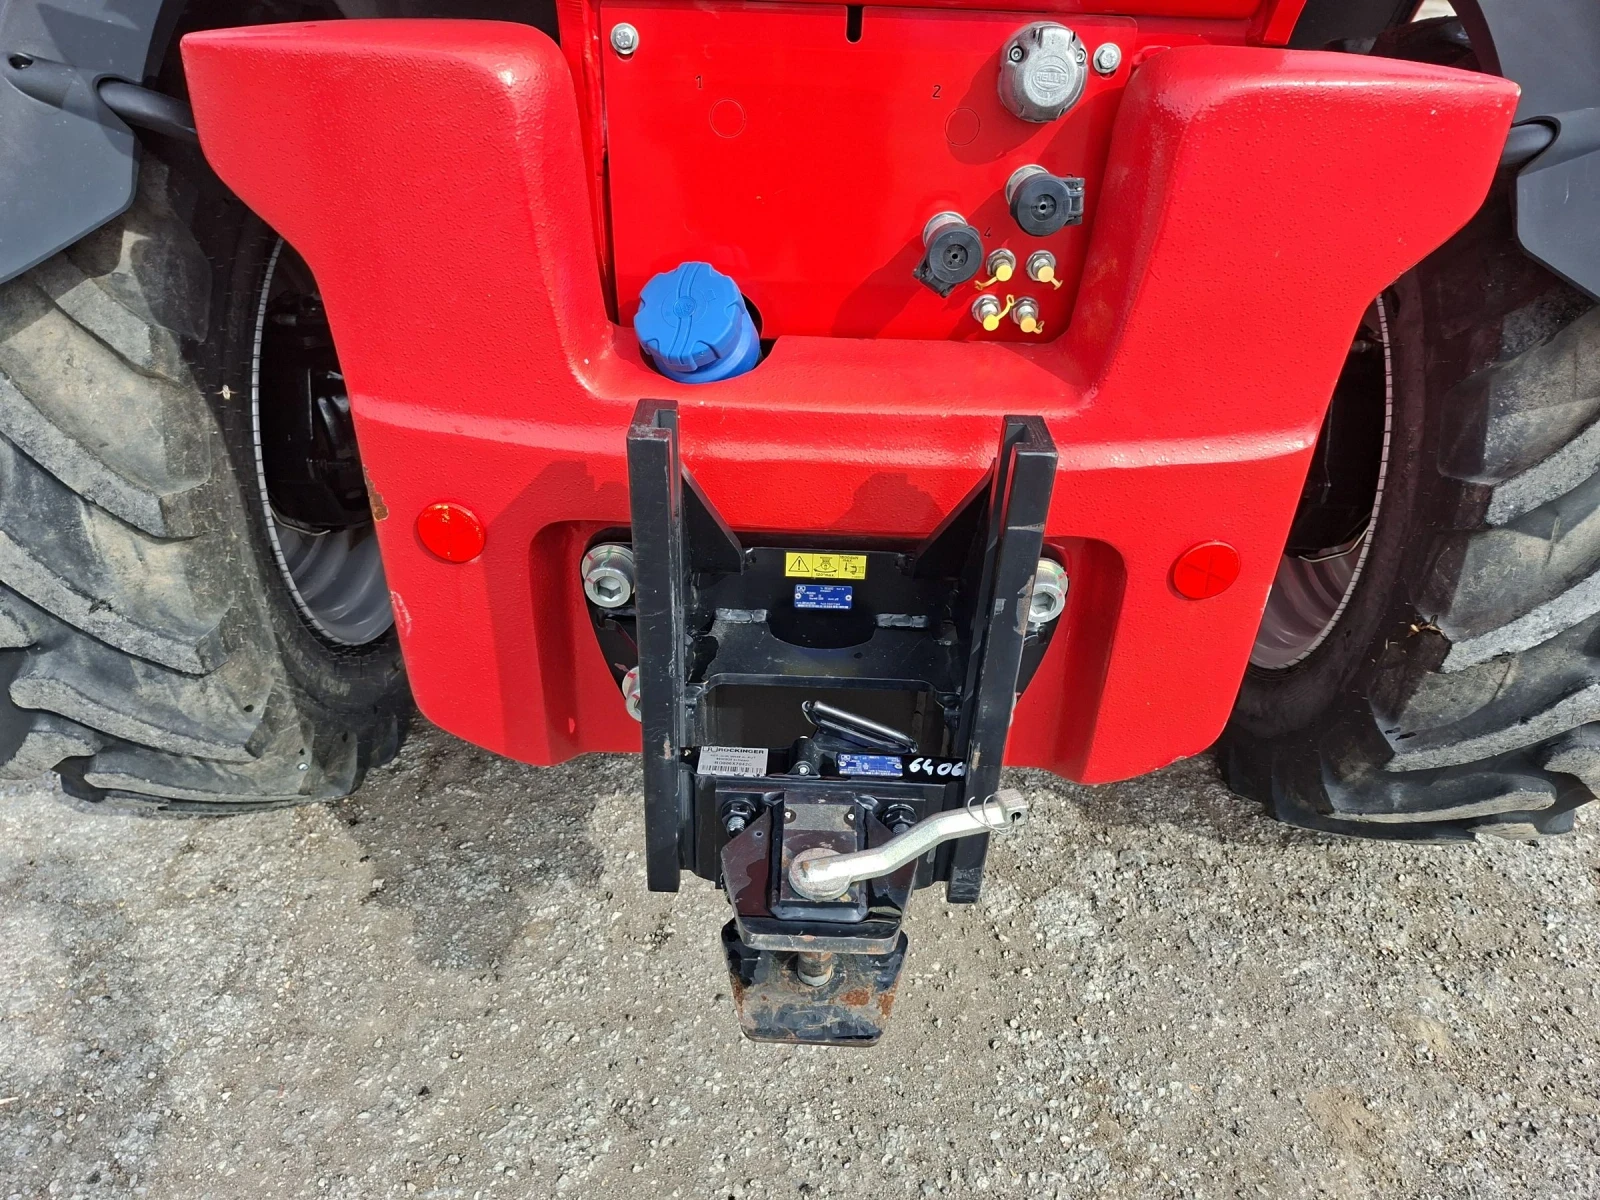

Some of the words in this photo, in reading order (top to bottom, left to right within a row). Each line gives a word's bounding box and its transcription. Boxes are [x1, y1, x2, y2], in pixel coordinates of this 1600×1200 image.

[695, 75, 702, 89] 1
[932, 84, 941, 98] 2
[983, 226, 991, 237] 4
[909, 757, 966, 776] 6406
